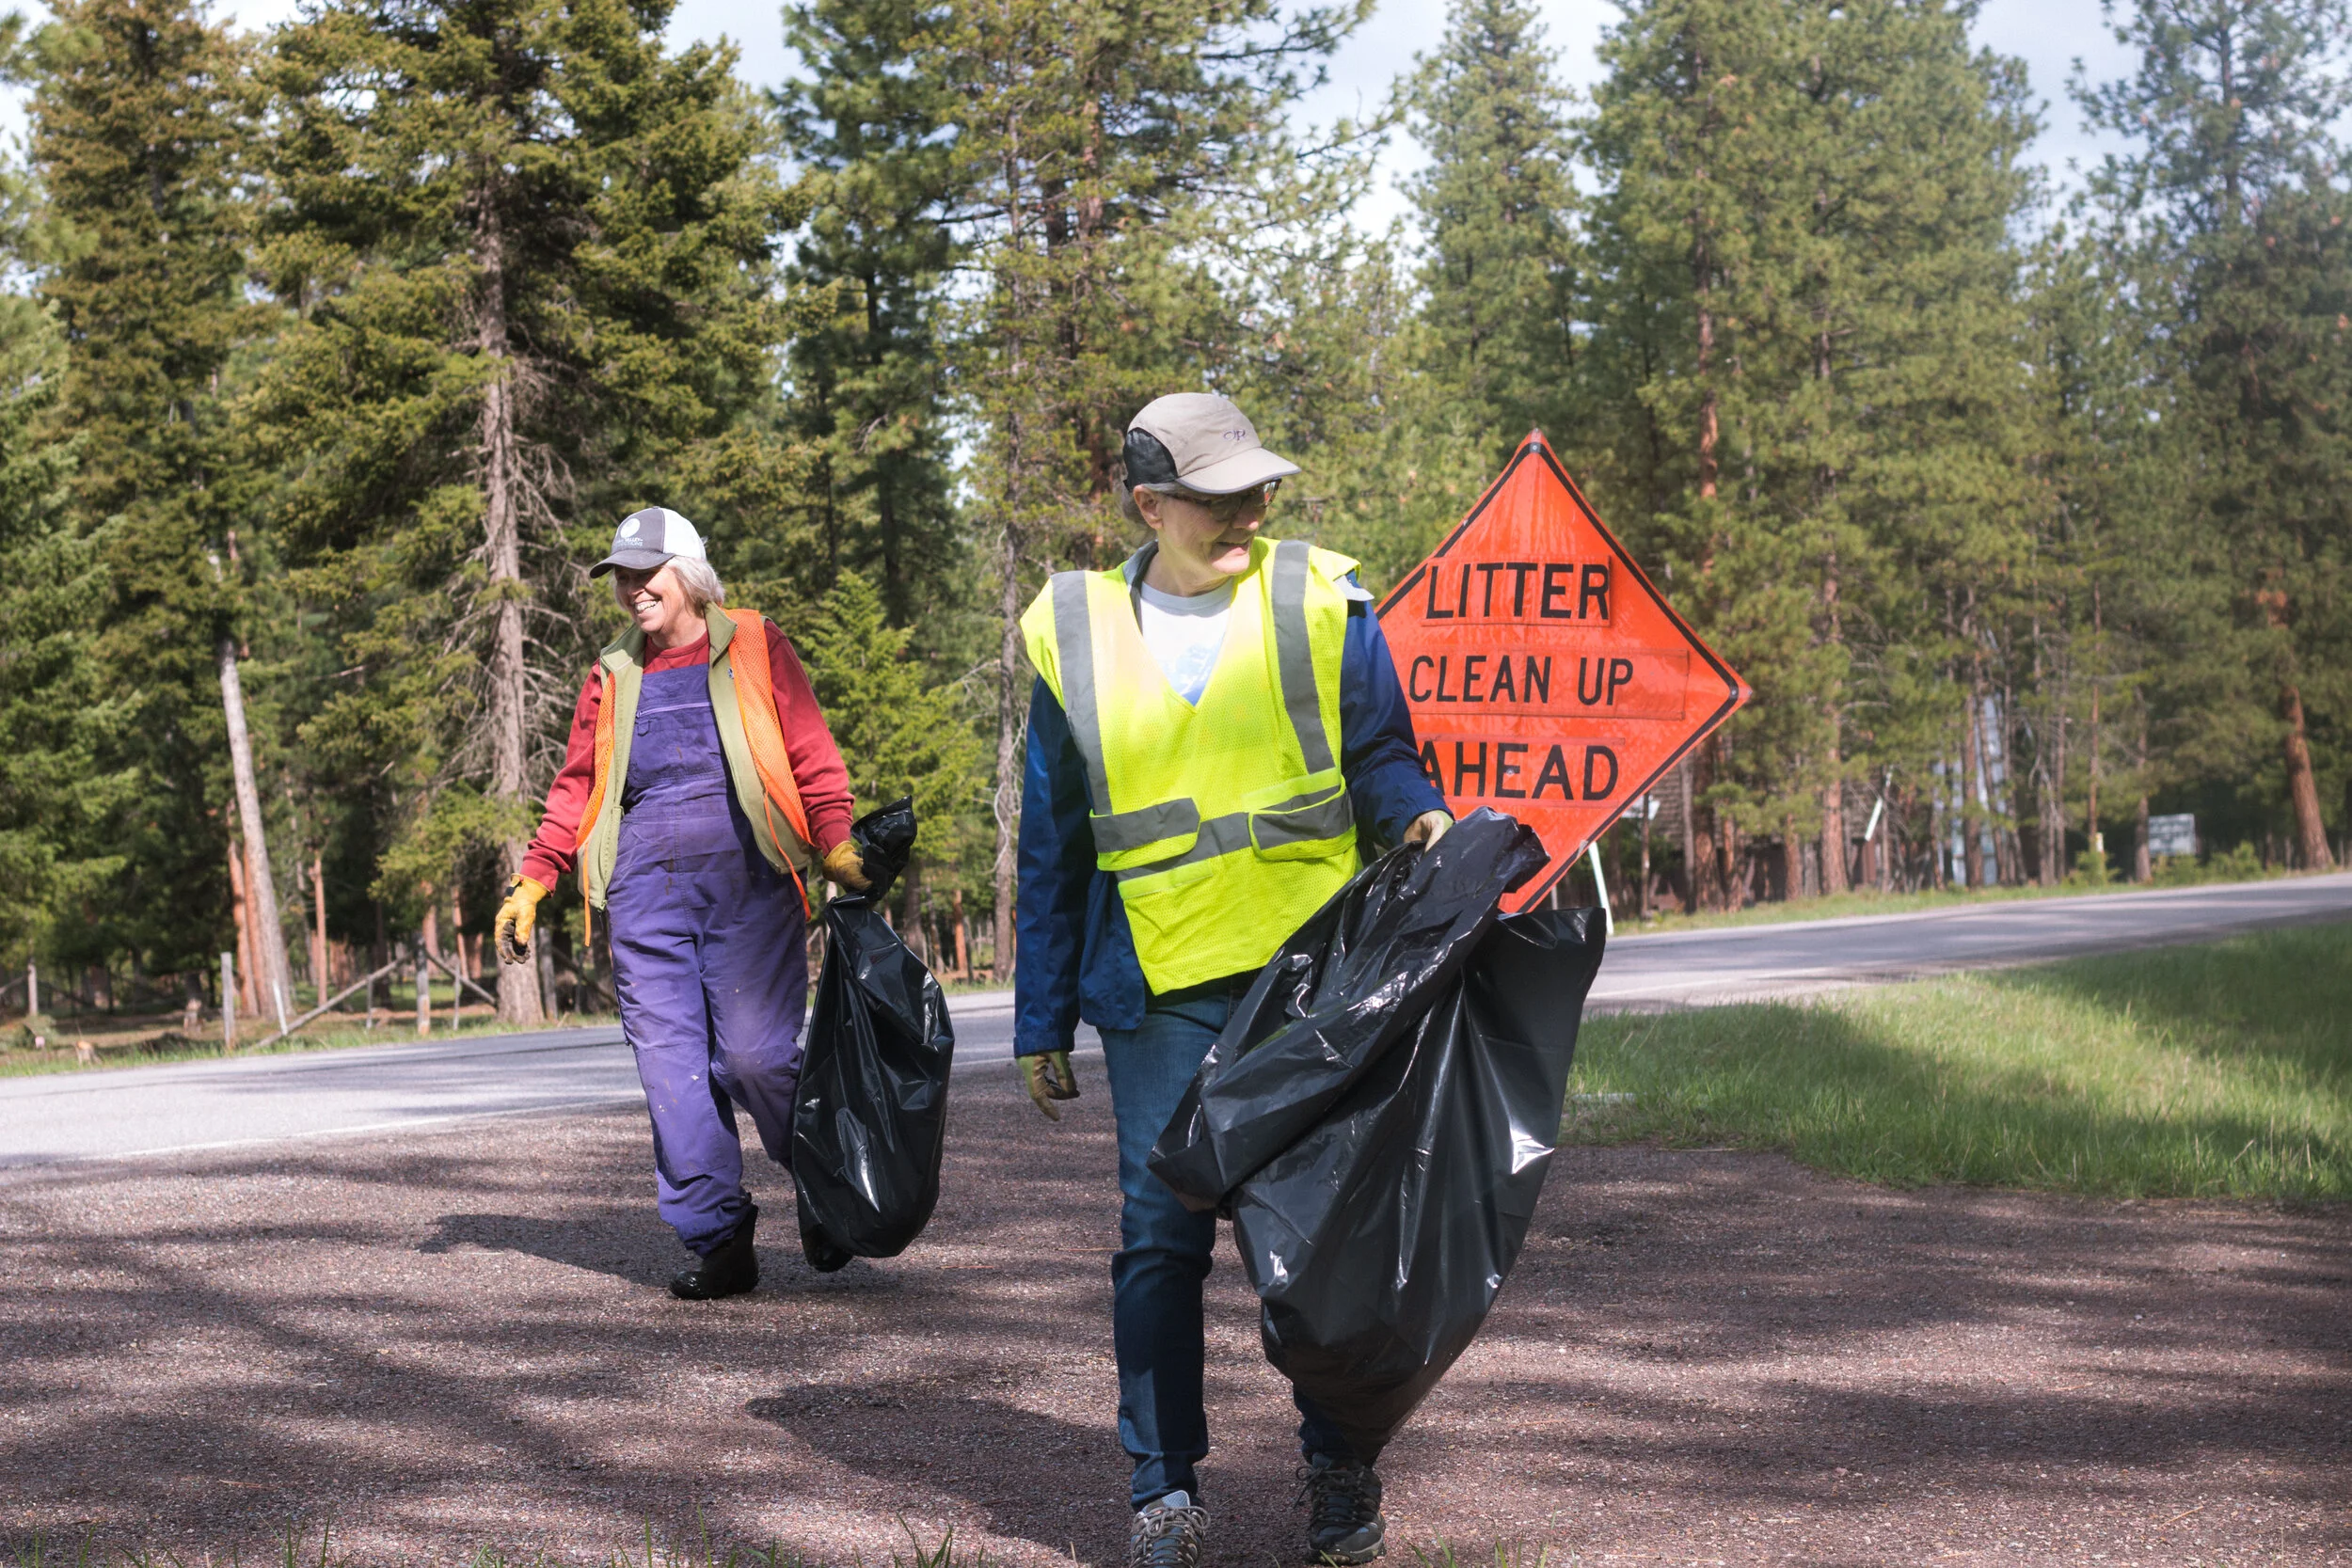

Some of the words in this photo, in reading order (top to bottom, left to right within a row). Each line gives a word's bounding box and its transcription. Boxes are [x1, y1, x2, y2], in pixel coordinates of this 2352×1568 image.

[1425, 562, 1610, 620] LITTER
[1408, 655, 1551, 704] CLEAN
[1578, 657, 1633, 706] UP
